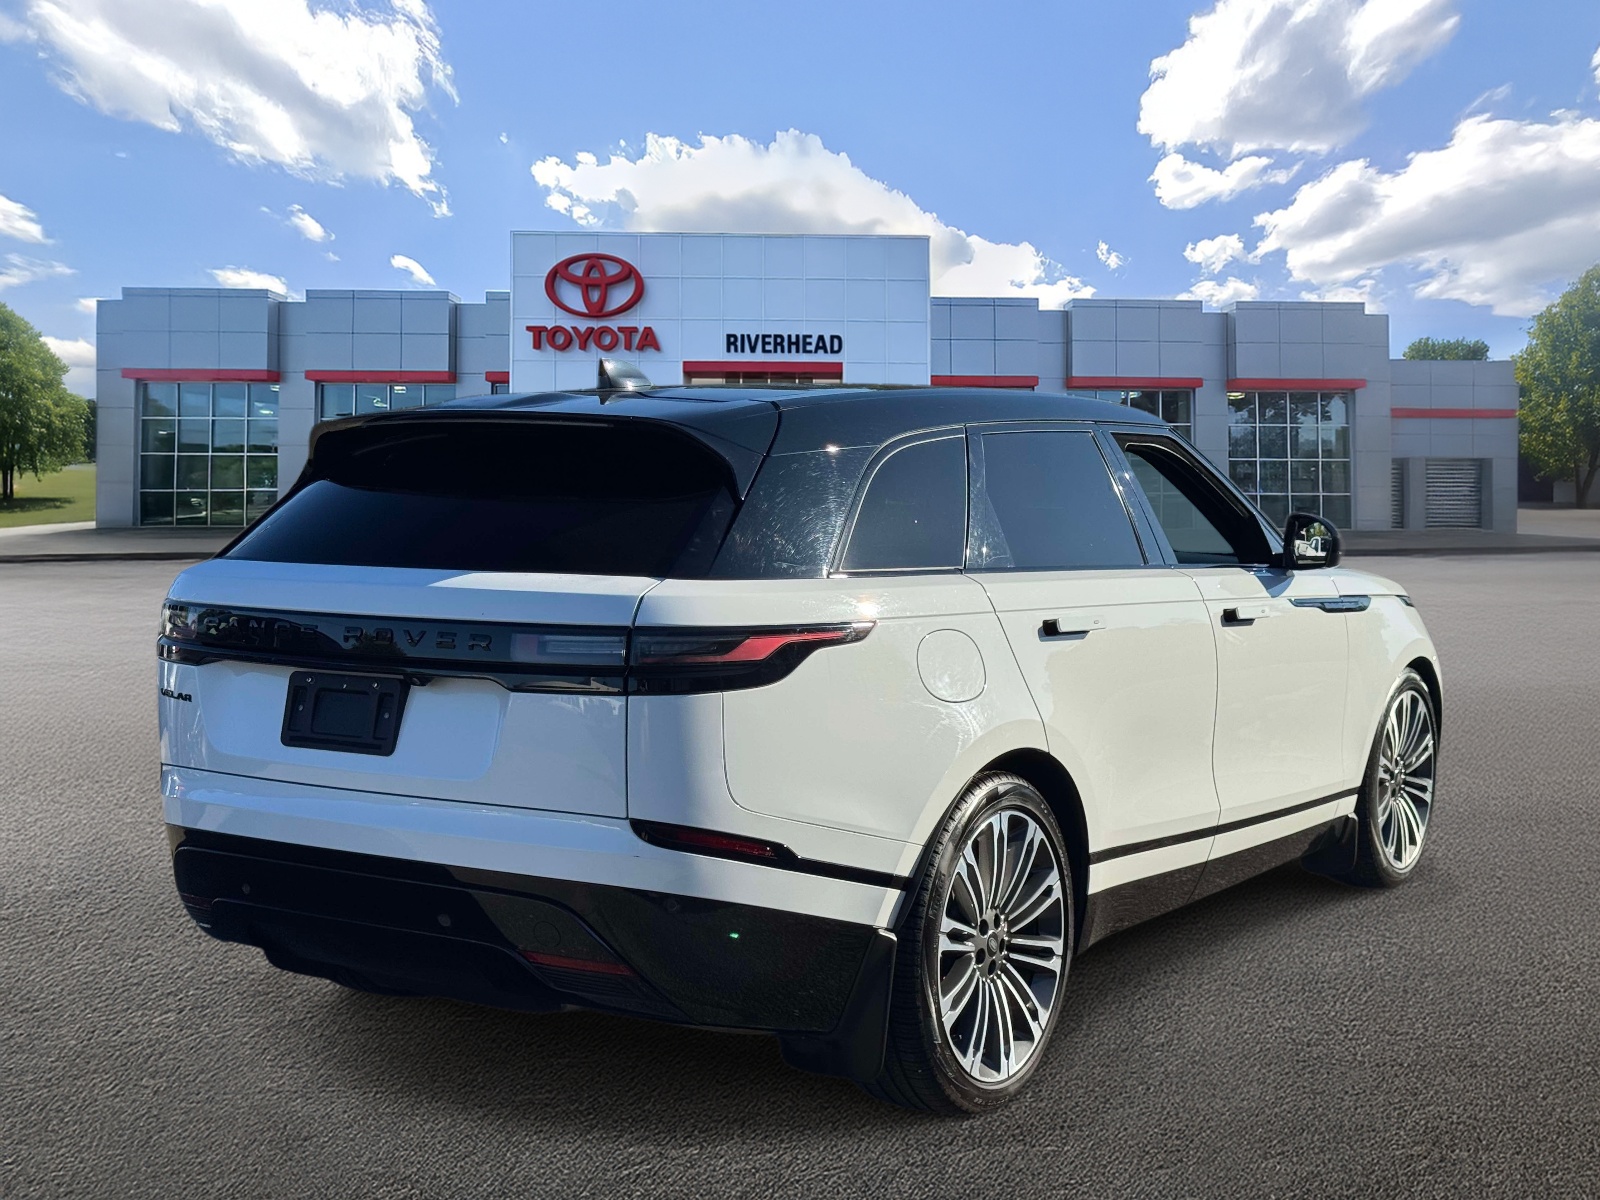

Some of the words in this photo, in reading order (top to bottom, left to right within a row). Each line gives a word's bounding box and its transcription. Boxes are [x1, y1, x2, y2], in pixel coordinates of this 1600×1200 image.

[526, 325, 661, 352] TOYOTA
[725, 333, 843, 355] RIVERHEAD
[343, 626, 493, 652] ROVER
